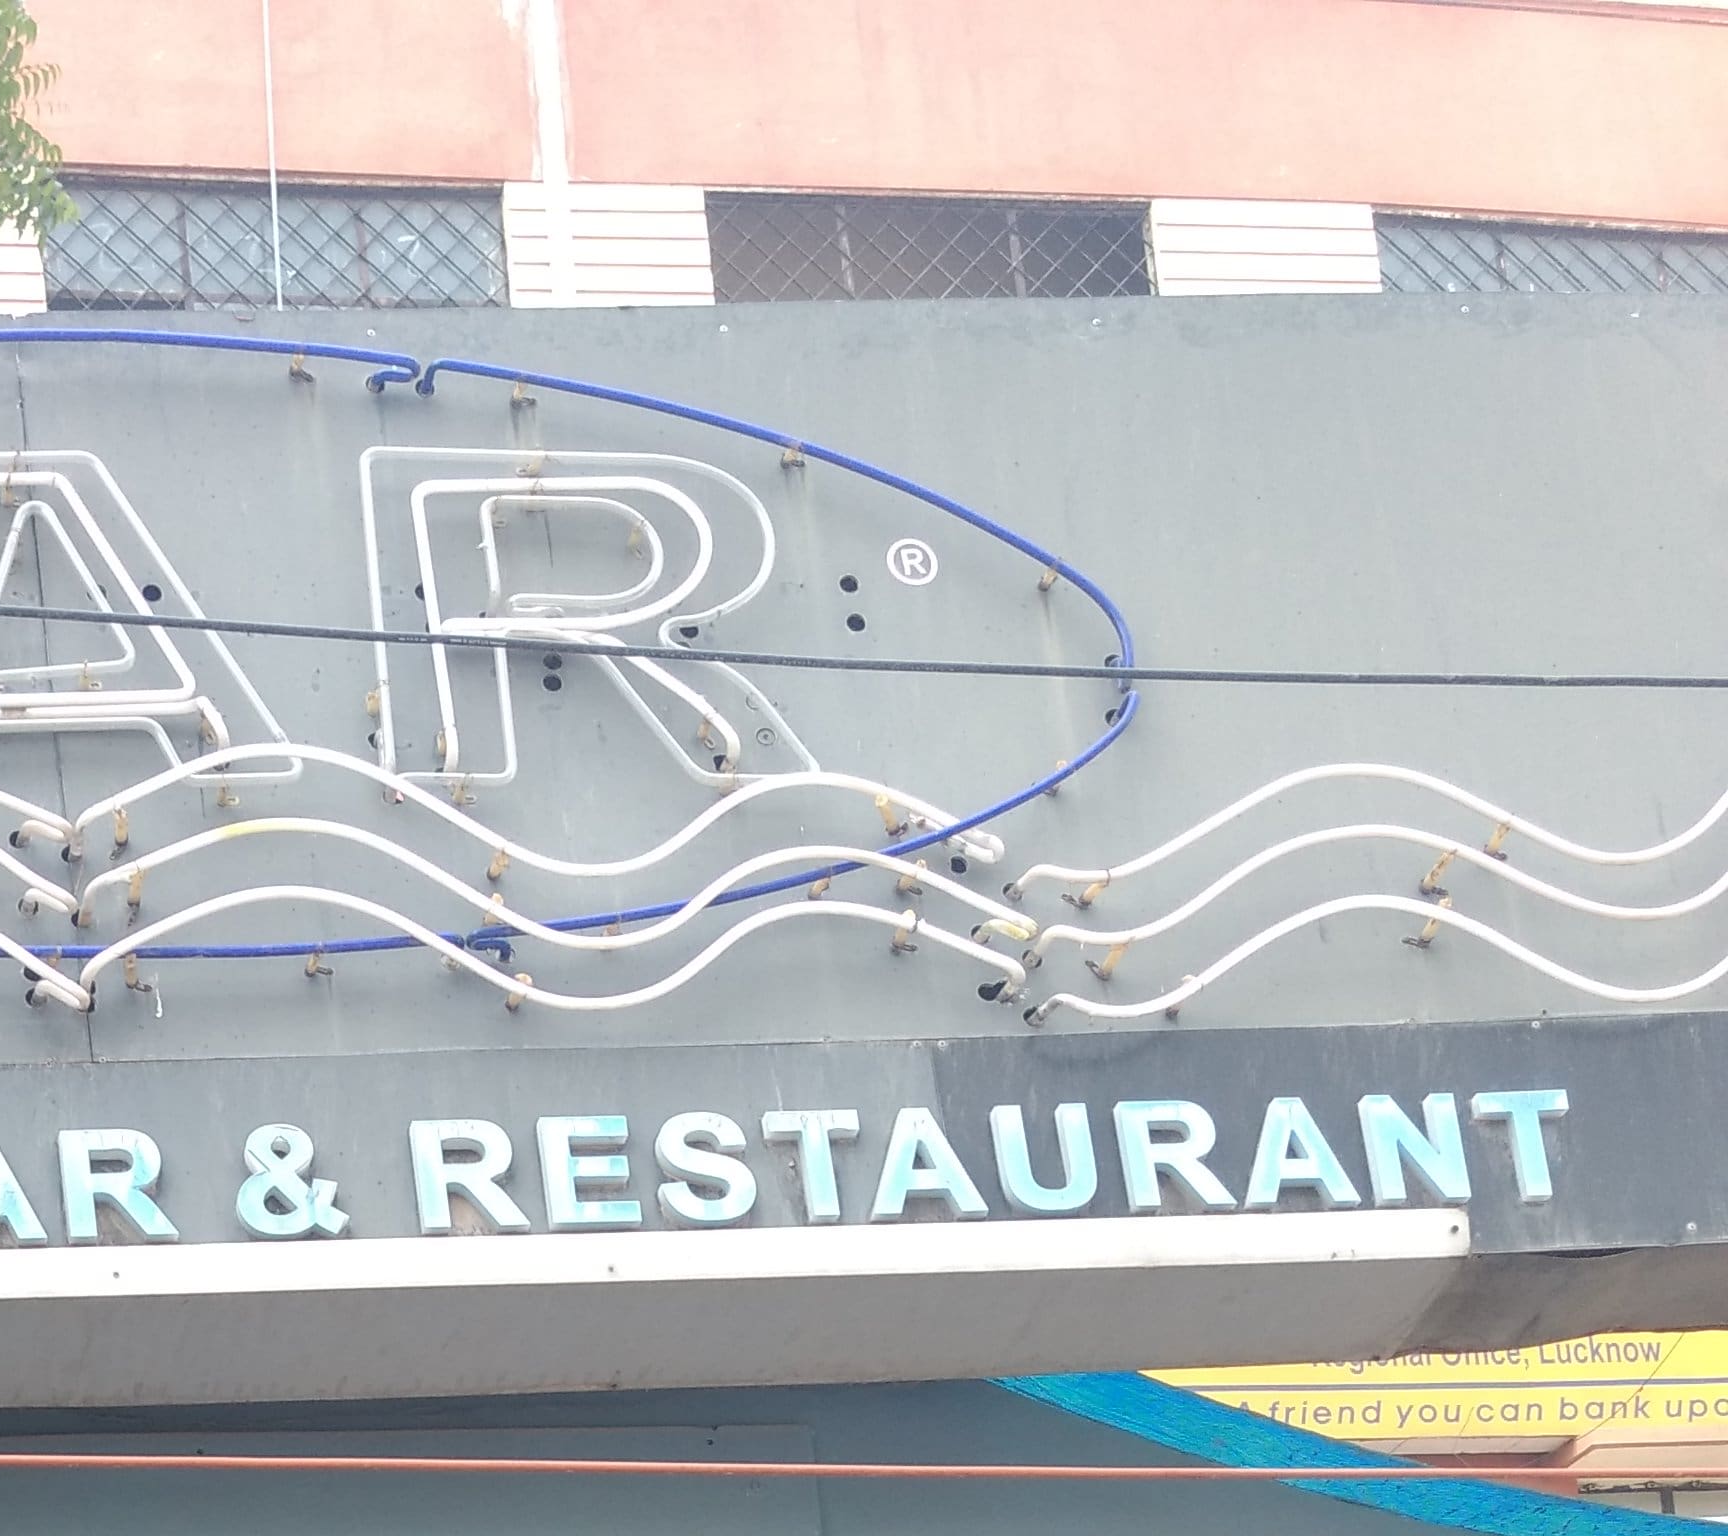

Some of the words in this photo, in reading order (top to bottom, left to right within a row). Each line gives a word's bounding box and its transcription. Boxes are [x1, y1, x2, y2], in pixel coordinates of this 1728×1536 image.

[235, 1122, 351, 1241] &
[407, 1088, 1570, 1236] RESTAURANT
[1539, 1334, 1662, 1366] Lucknow
[1267, 1399, 1382, 1426] friend
[1397, 1401, 1462, 1429] you
[1474, 1400, 1543, 1423] can
[1559, 1395, 1652, 1421] bank
